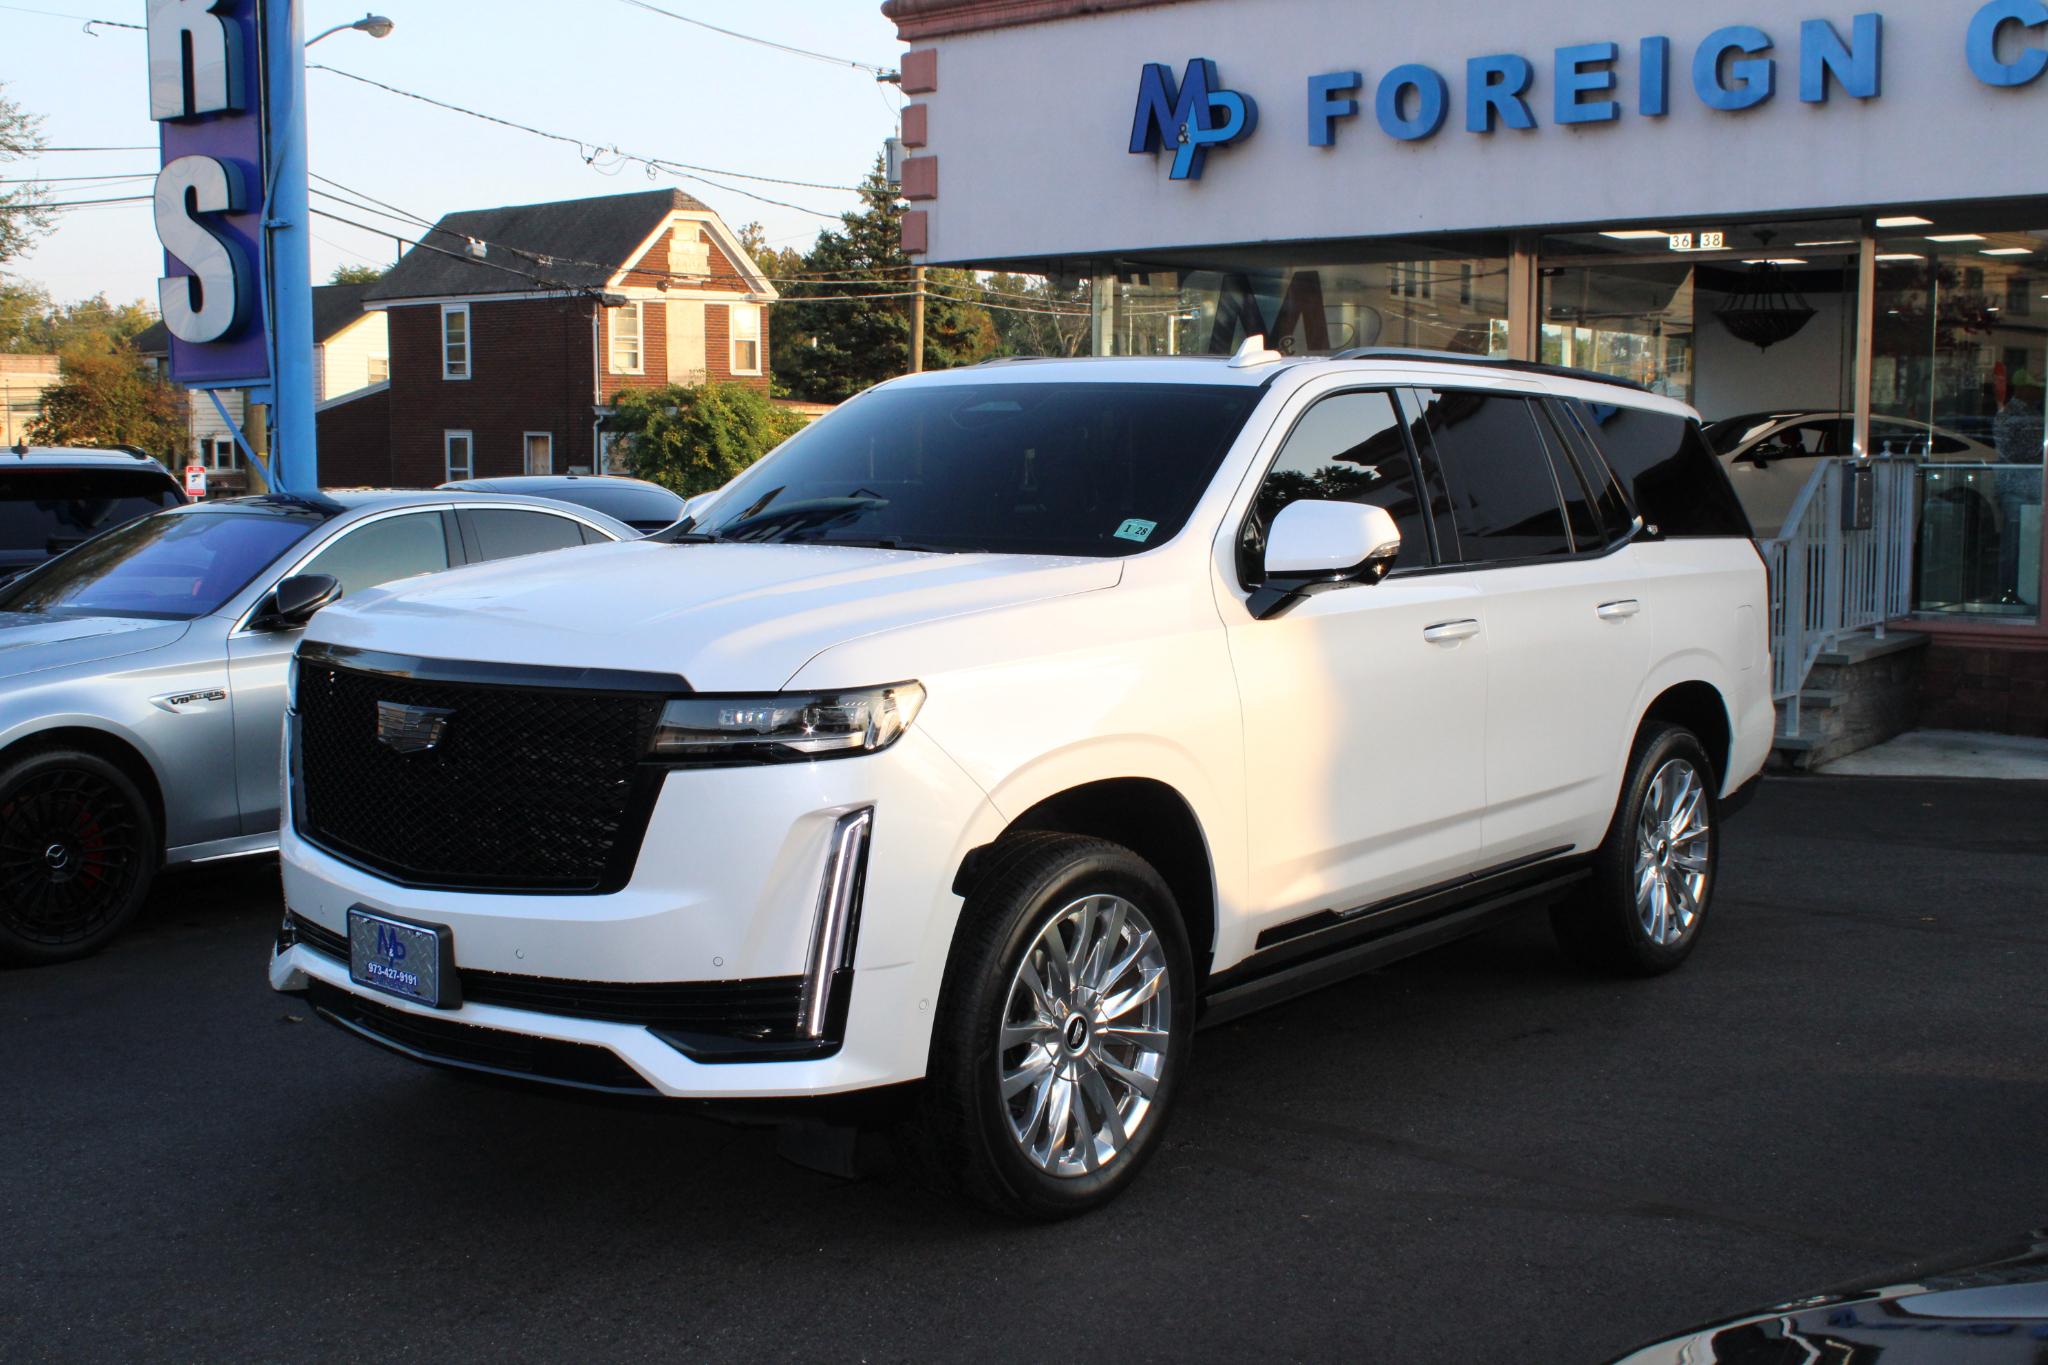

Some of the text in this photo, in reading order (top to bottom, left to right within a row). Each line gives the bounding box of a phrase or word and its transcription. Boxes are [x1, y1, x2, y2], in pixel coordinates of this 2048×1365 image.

[1308, 12, 1884, 147] FOREIGN
[1134, 526, 1149, 536] 28
[367, 961, 418, 987] 973-427-9191
